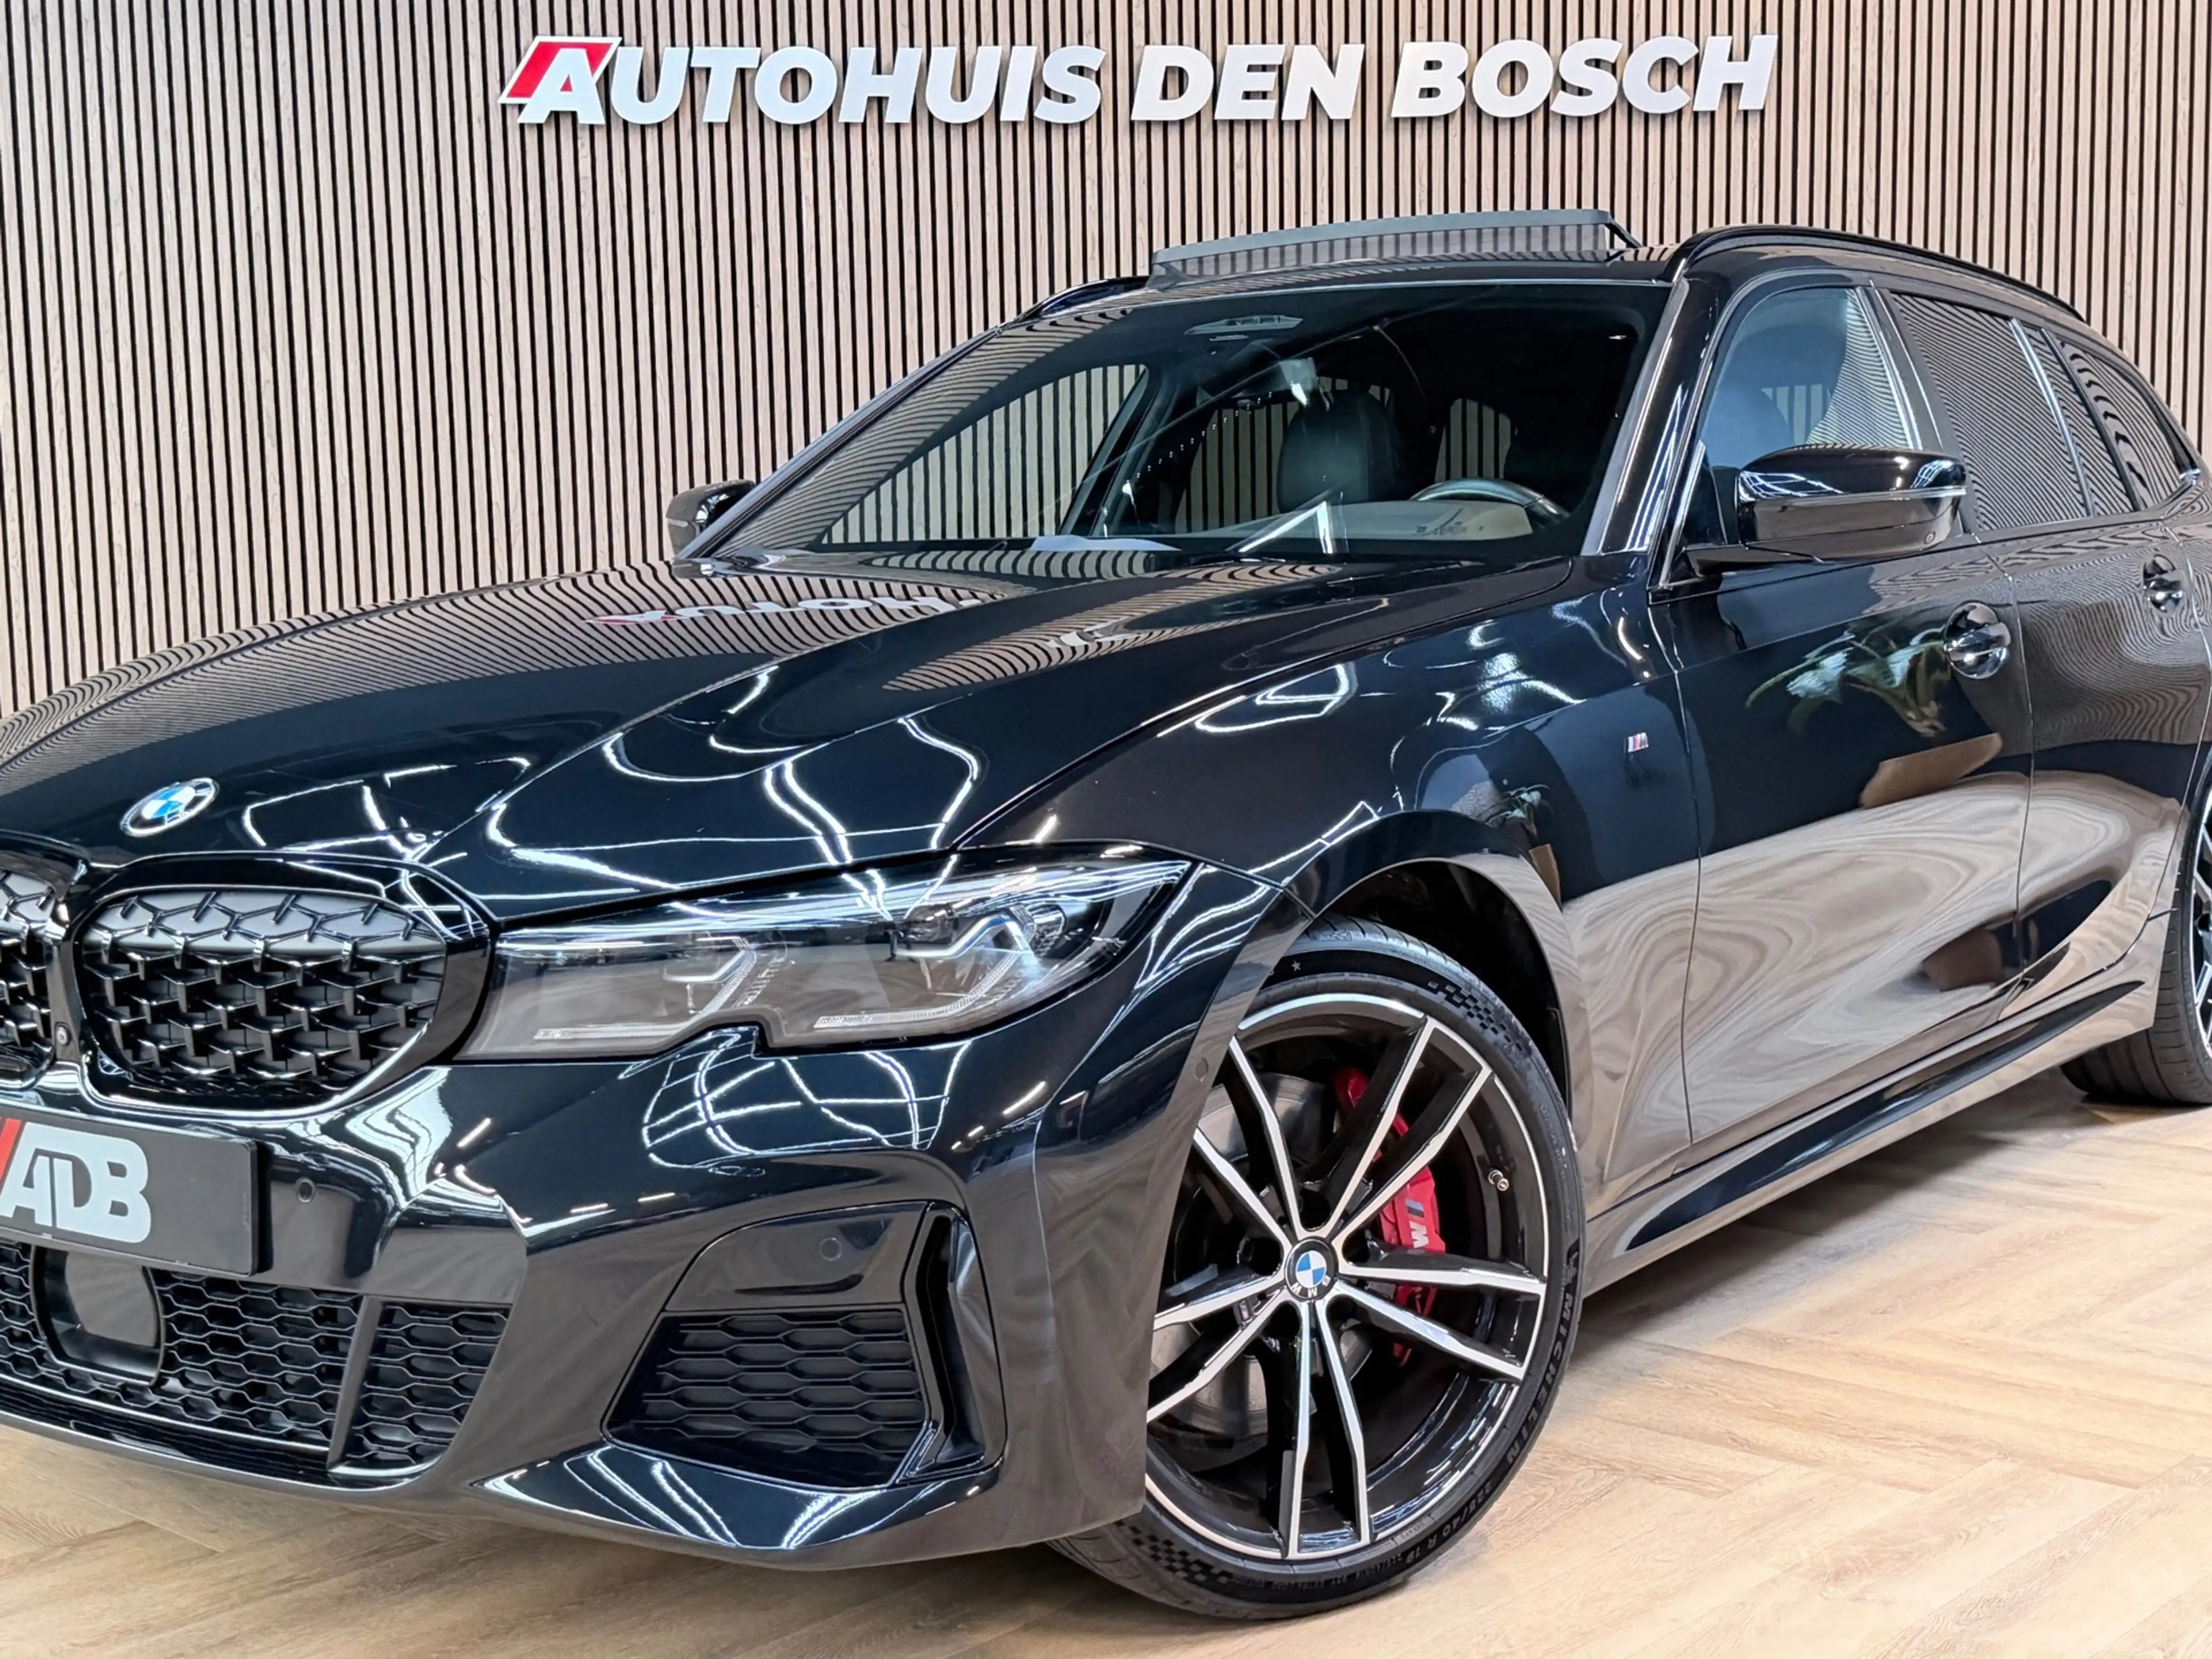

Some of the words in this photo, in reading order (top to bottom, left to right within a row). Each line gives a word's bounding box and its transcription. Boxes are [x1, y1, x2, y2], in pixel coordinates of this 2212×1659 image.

[498, 36, 1106, 124] AUTOHUIS
[1131, 43, 1365, 120] DEN
[1391, 35, 1778, 118] BOSCH
[0, 1122, 151, 1243] ADB
[1290, 1275, 1331, 1298] BMW
[1506, 1293, 1574, 1464] MICHELIN
